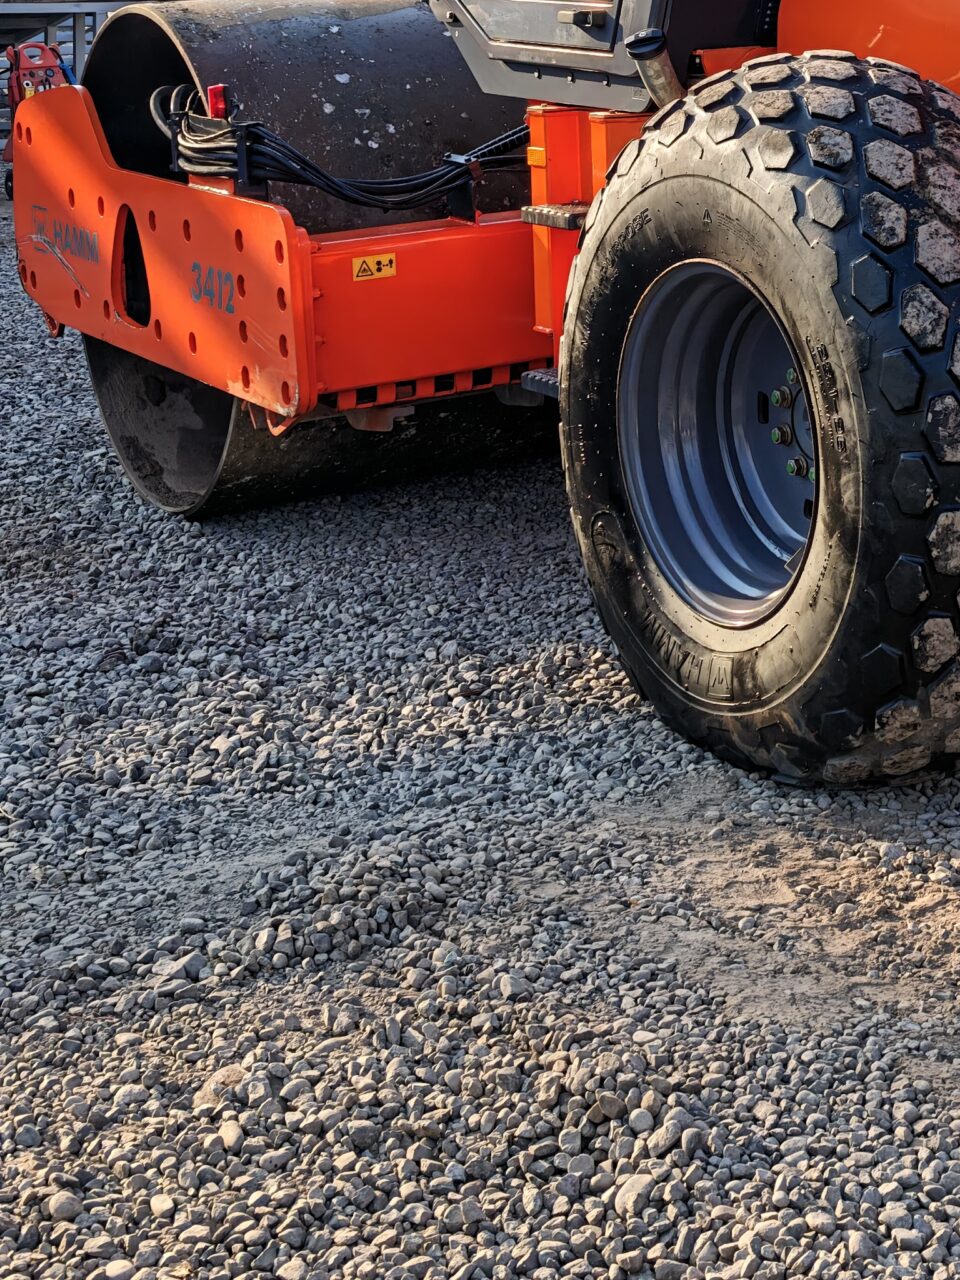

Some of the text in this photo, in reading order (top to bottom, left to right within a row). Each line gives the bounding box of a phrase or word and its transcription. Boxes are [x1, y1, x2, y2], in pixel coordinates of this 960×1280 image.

[53, 219, 98, 265] HAMM
[191, 261, 235, 314] 3412
[640, 609, 704, 686] HAMM
